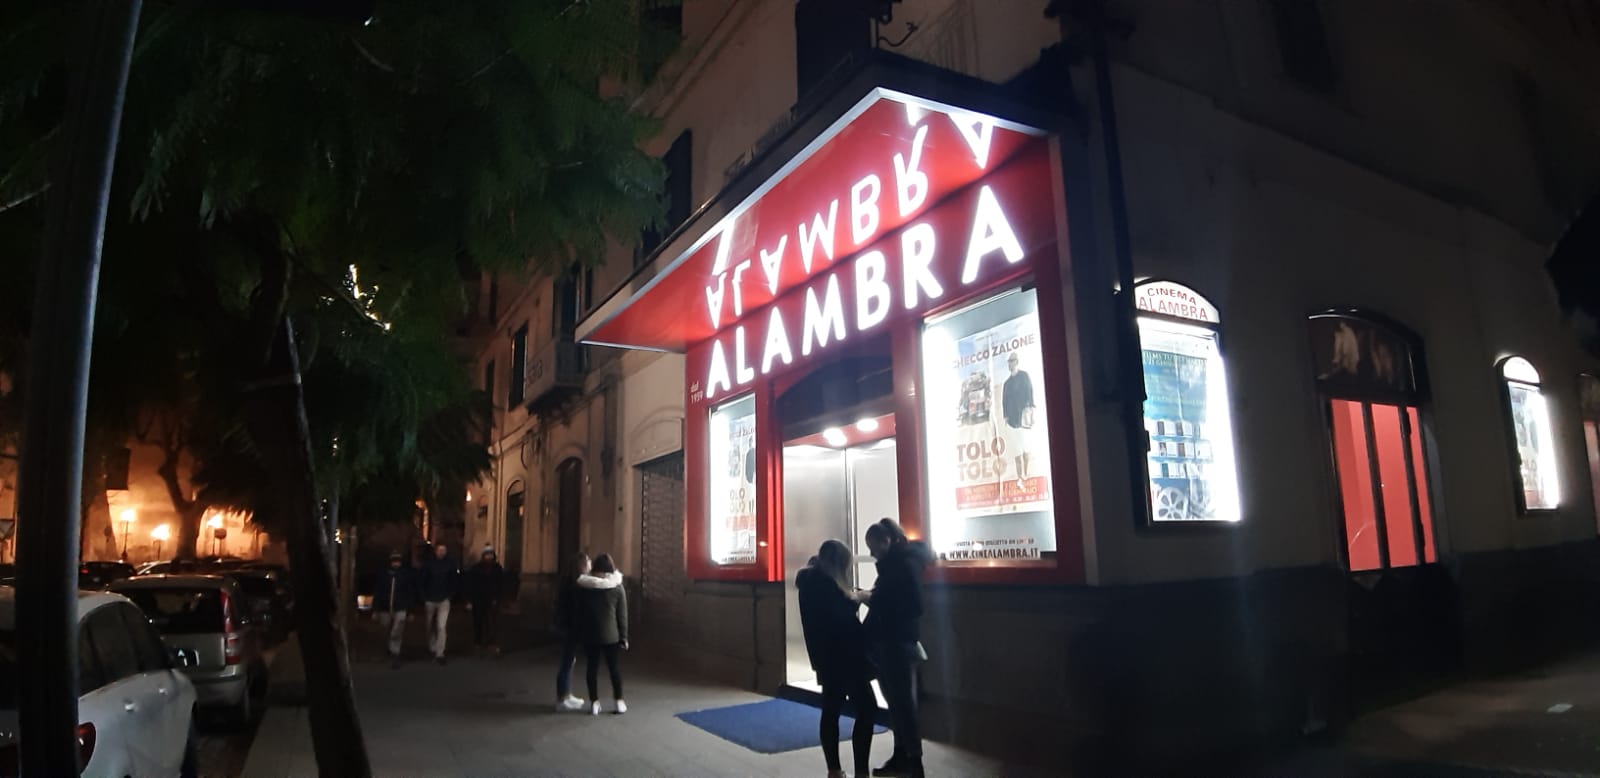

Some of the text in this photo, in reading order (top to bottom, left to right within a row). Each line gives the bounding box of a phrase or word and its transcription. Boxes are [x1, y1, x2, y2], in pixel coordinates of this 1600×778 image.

[706, 185, 1025, 398] ALAMBRA
[1147, 287, 1197, 305] CINEMA
[1138, 296, 1209, 320] ALAMBRA
[992, 333, 1035, 357] ZALONE
[956, 436, 1006, 462] TOLO
[957, 457, 1008, 482] TOLO
